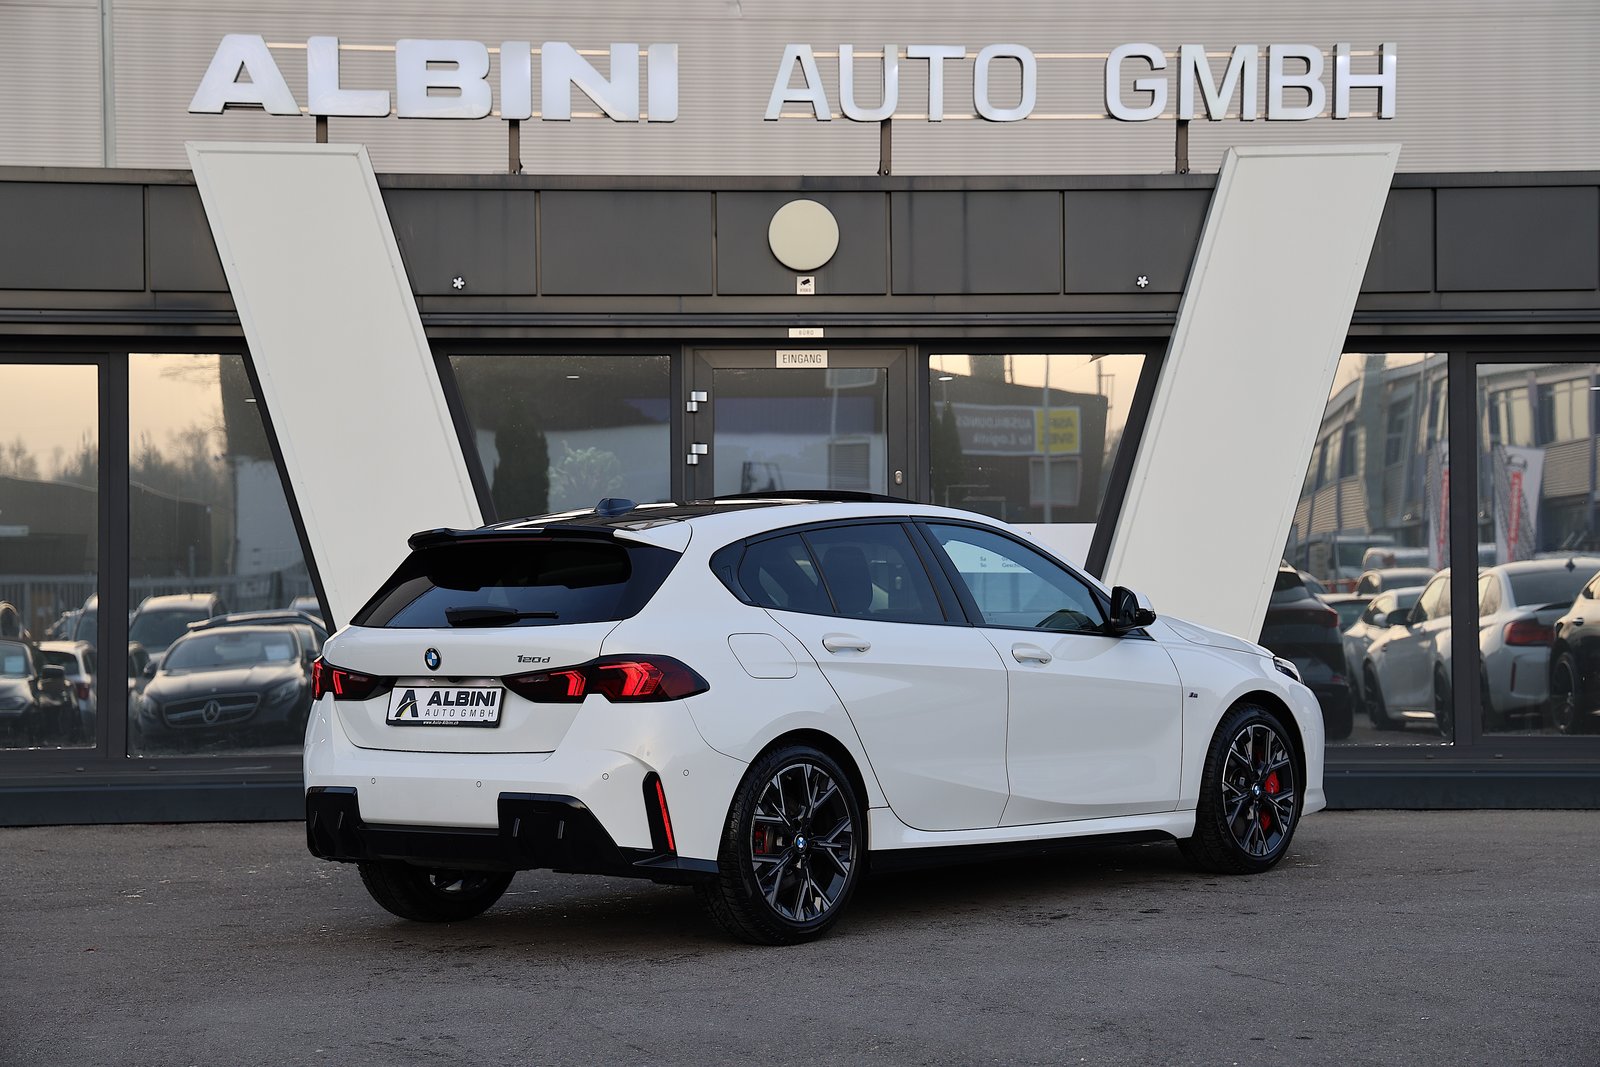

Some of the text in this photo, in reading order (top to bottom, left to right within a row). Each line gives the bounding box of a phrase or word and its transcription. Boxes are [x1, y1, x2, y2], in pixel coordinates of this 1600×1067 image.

[188, 34, 1397, 123] ALBINI AUTO GMBH
[782, 353, 822, 364] EINGANG
[517, 654, 551, 663] 120d
[427, 690, 497, 707] ALBINI
[425, 708, 494, 718] AUTO GMBH
